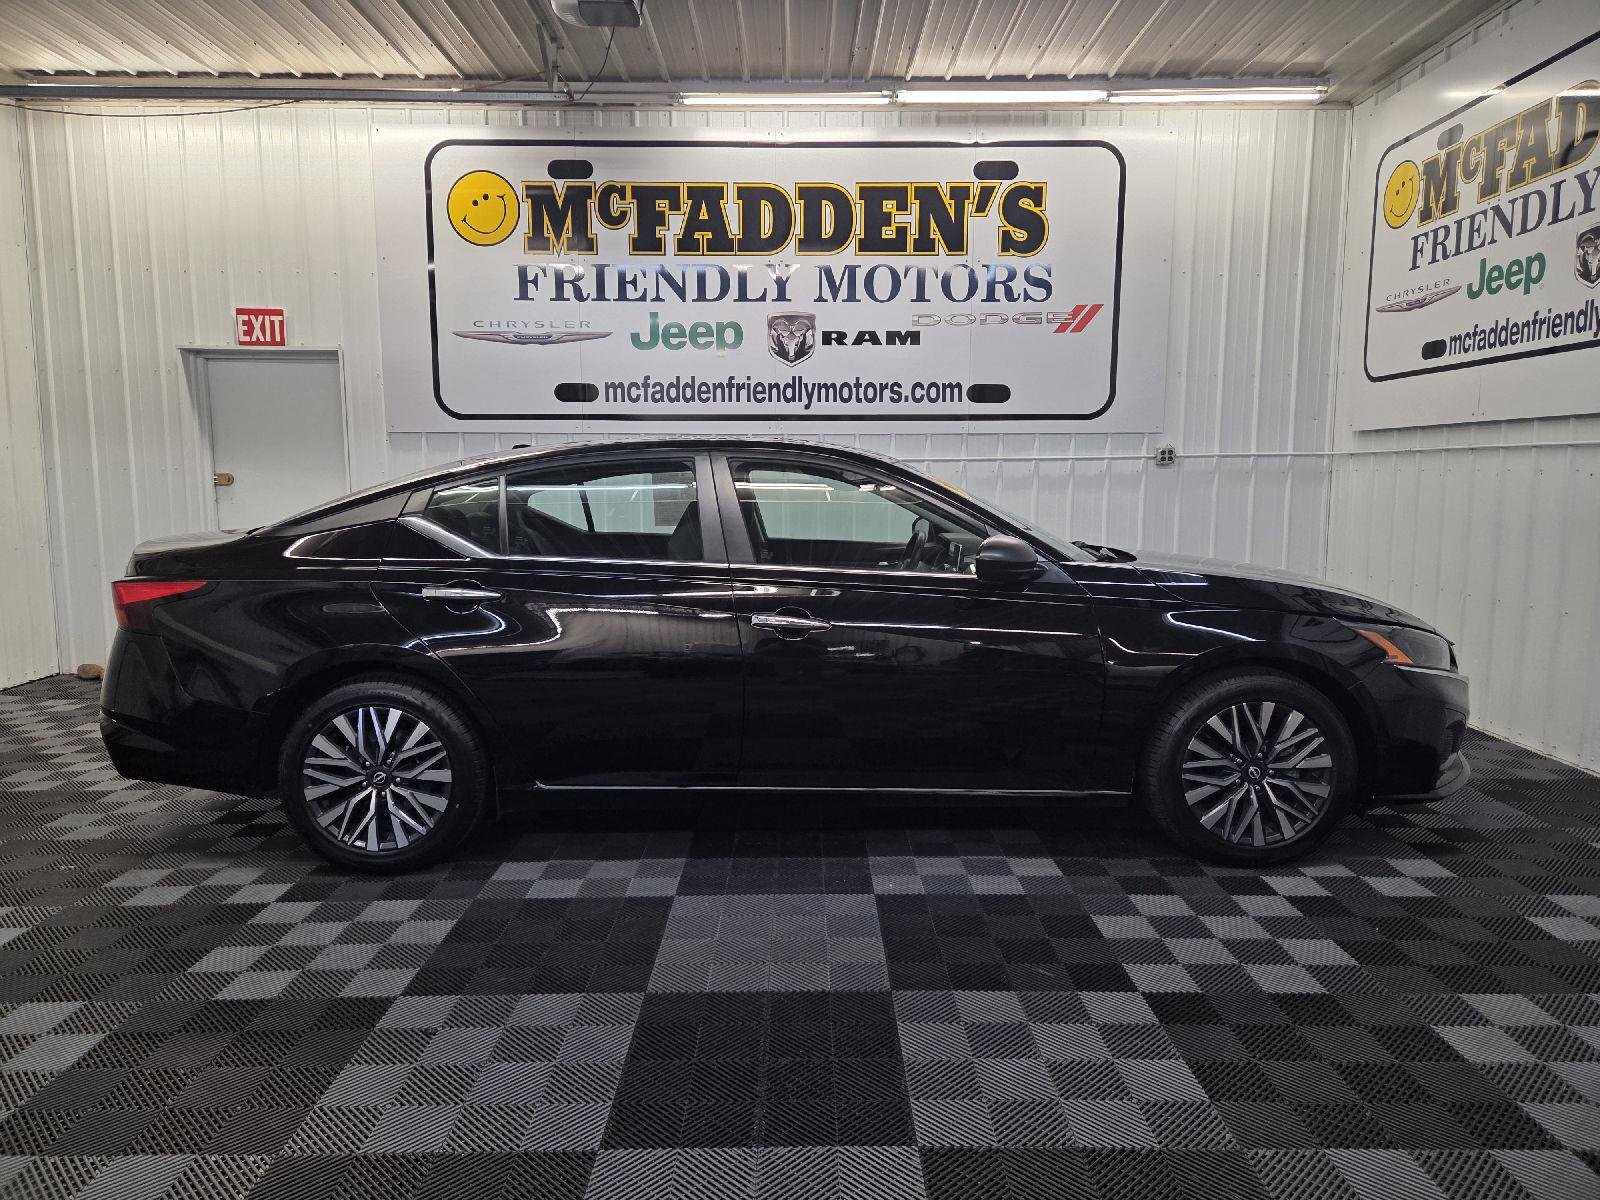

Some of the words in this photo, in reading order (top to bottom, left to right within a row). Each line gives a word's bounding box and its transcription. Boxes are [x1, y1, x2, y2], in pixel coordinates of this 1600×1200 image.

[1408, 165, 1600, 272] FRIENDLY
[513, 263, 800, 303] FRIENDLY
[813, 263, 1053, 303] MOTORS
[1386, 278, 1451, 302] CHRYSLER
[1466, 252, 1547, 300] Jeep
[236, 314, 283, 342] EXIT
[473, 320, 591, 329] CHRYSLER
[630, 312, 744, 351] Jeep
[911, 311, 1077, 327] DODGE
[821, 330, 921, 346] RAM
[604, 375, 963, 410] mcfaddenfriendlymotors.com
